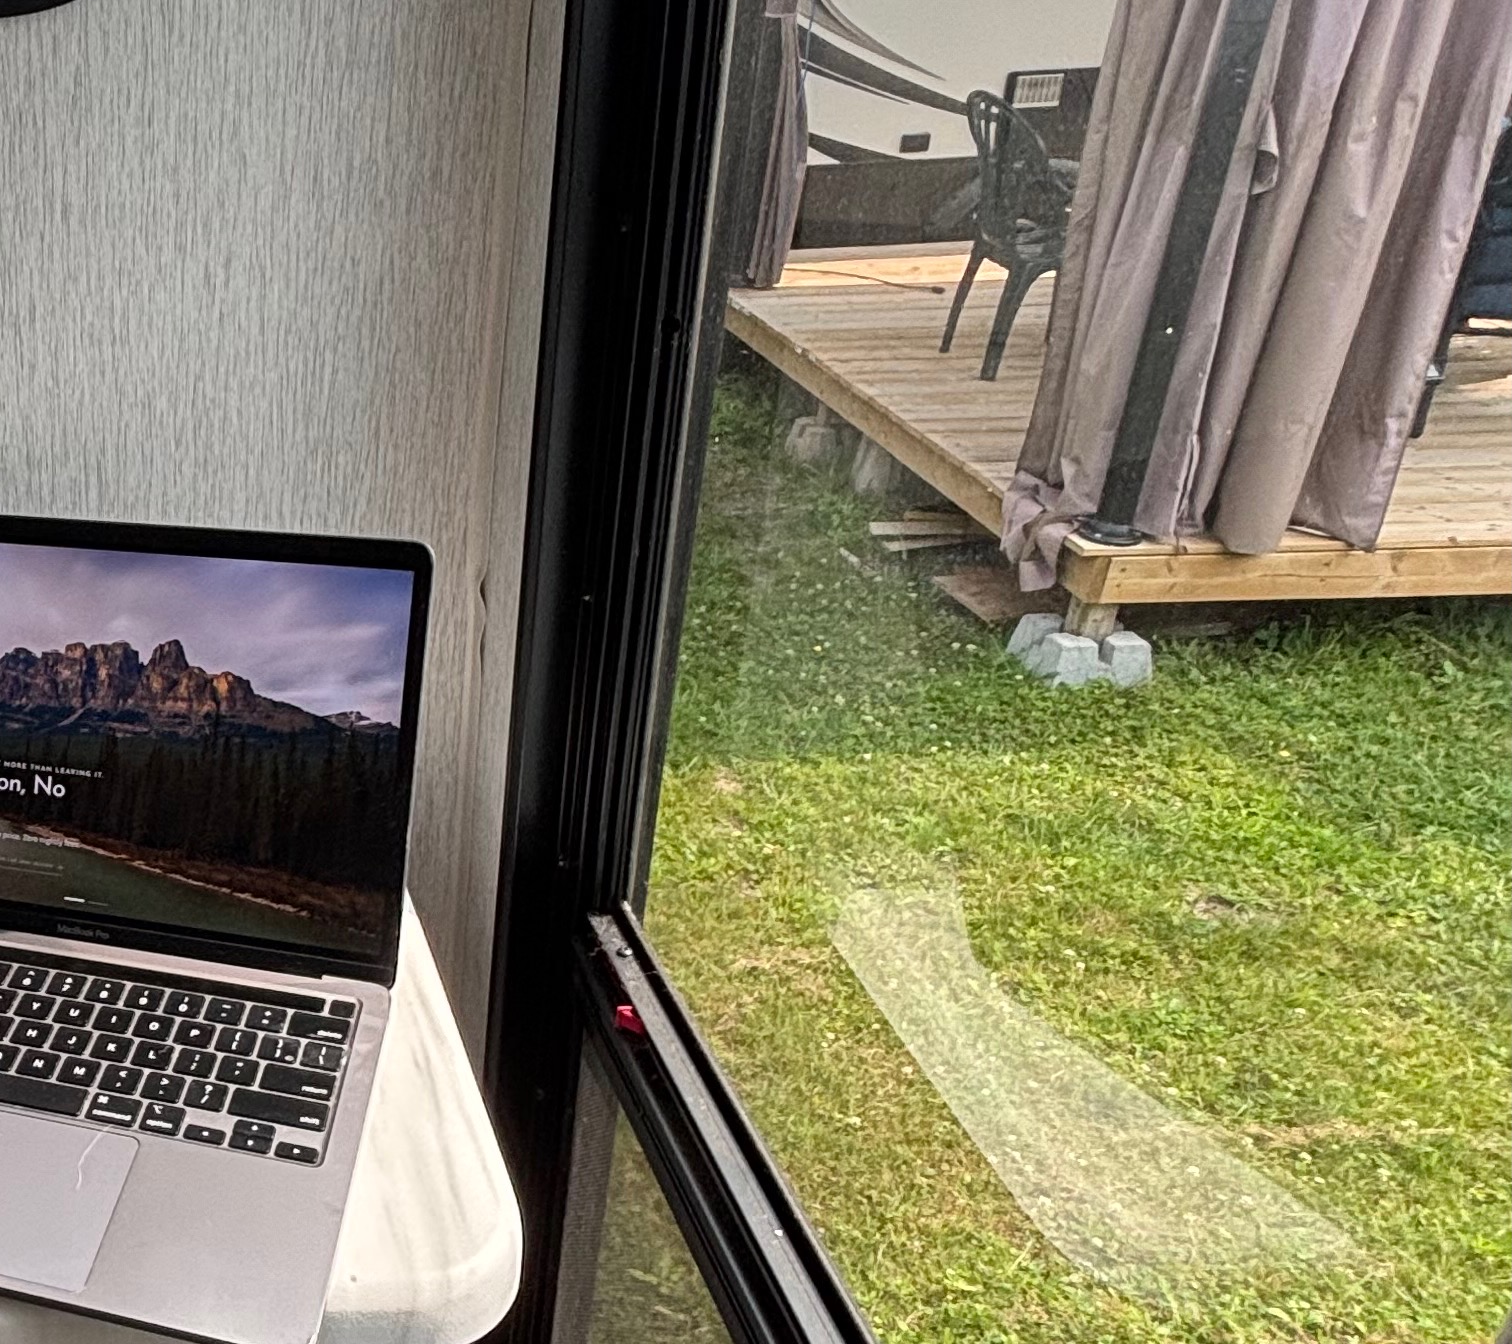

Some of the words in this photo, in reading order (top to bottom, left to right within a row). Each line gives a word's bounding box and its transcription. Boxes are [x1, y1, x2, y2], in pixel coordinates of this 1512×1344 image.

[3, 761, 27, 770] MORE
[30, 763, 52, 773] THAN
[55, 767, 91, 778] LEAVING
[33, 774, 66, 797] No
